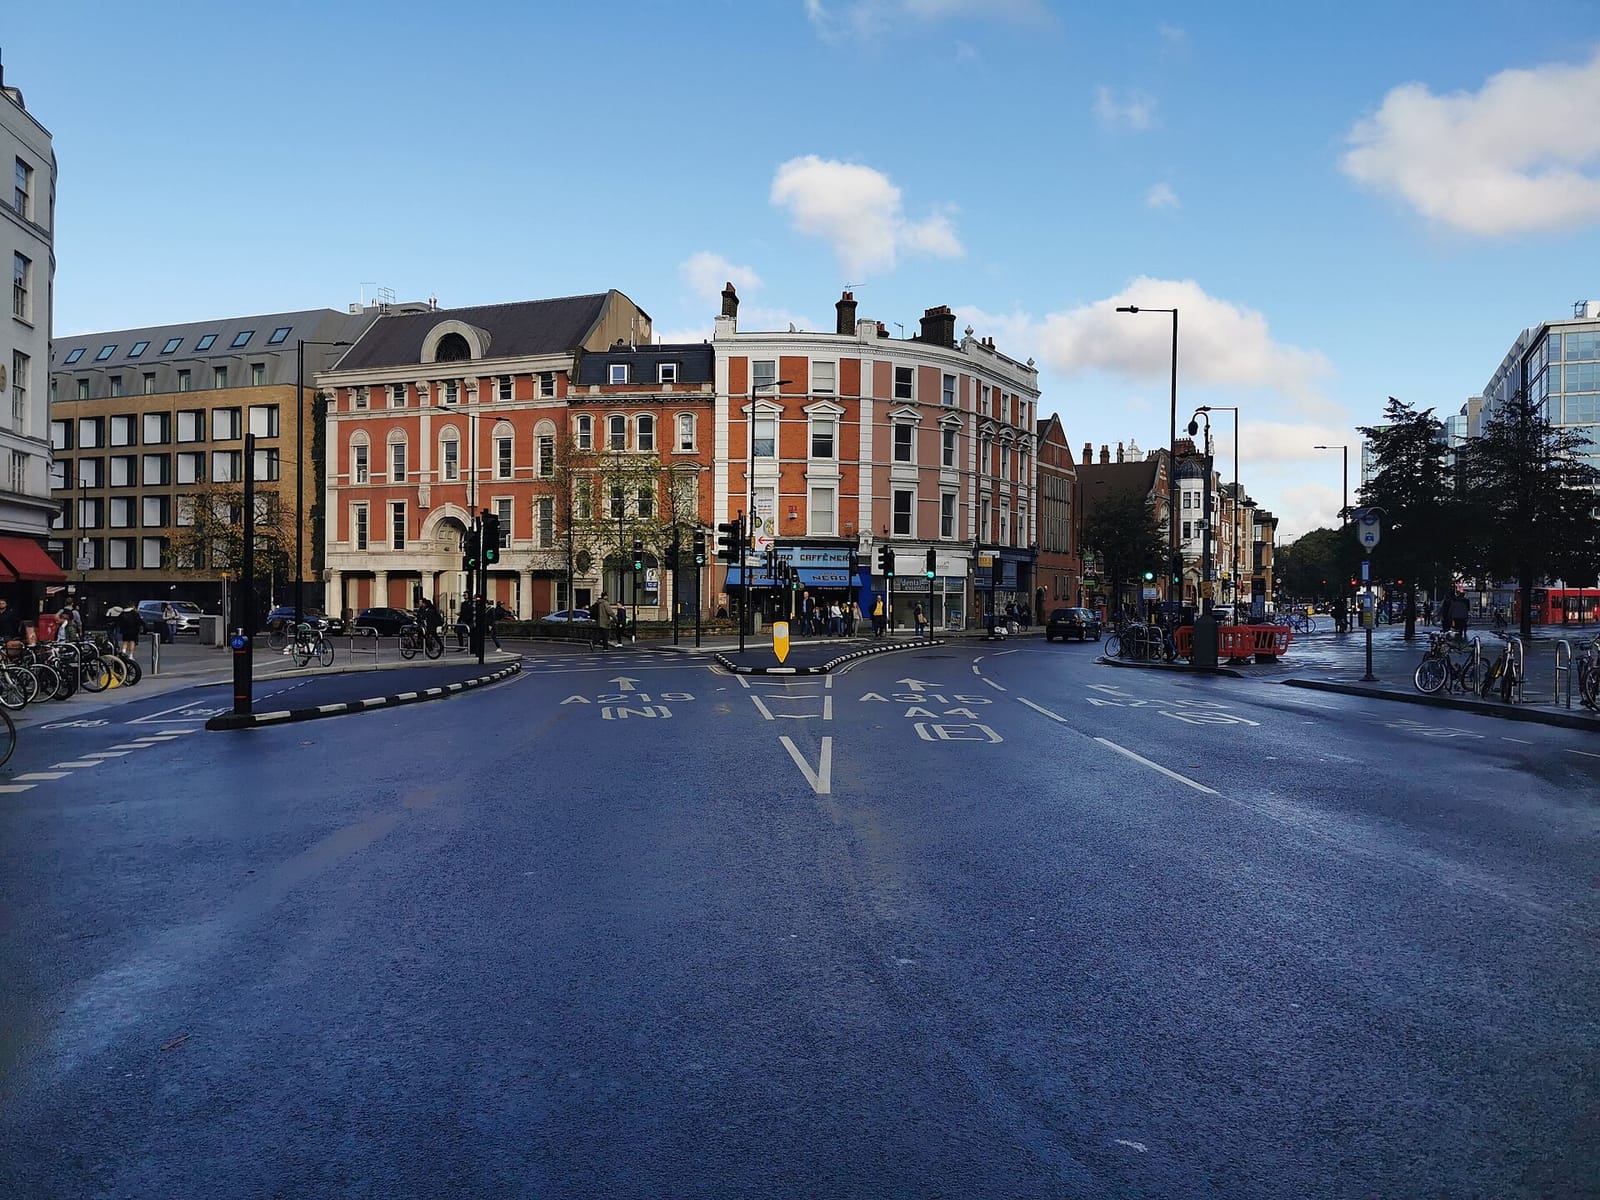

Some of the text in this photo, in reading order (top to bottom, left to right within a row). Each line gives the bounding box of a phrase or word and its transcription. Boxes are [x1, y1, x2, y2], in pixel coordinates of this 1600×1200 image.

[560, 692, 696, 704] A219
[858, 692, 993, 704] A315
[601, 706, 673, 719] (N)
[904, 706, 980, 719] A4
[913, 722, 1004, 743] (E)
